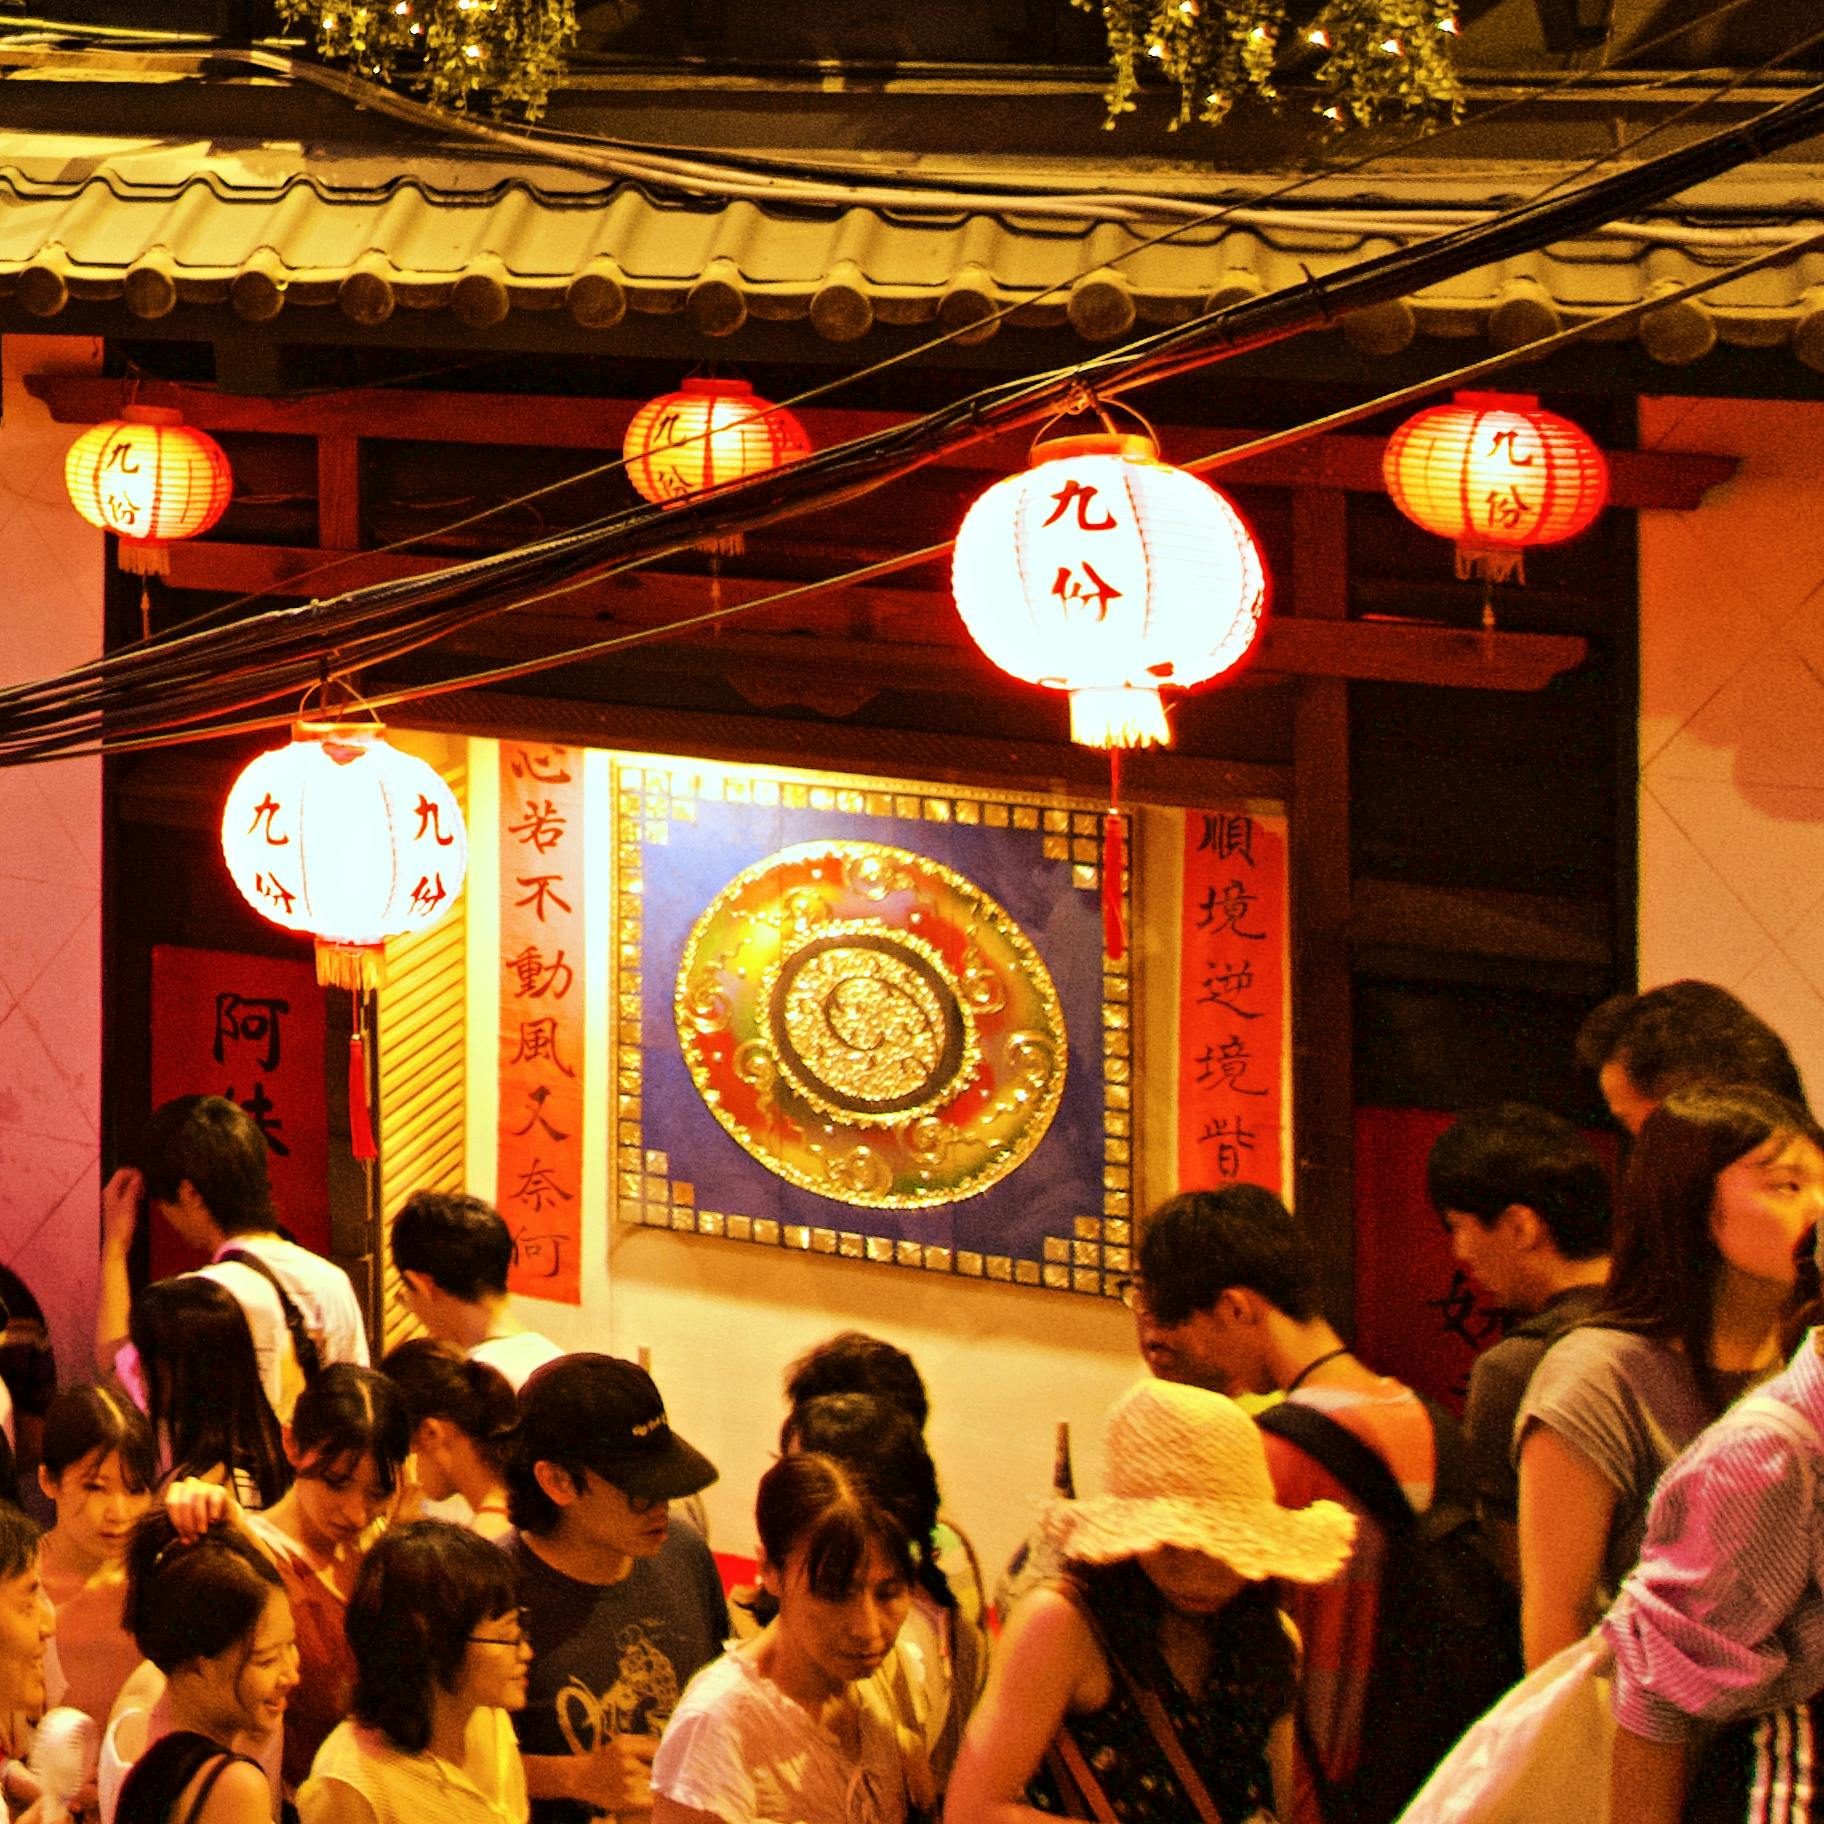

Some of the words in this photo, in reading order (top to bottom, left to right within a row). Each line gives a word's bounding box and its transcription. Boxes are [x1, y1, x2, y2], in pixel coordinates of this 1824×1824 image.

[106, 441, 141, 526] 九份
[1483, 430, 1532, 530] 九份
[1041, 478, 1123, 626] 九份
[245, 791, 297, 915] 九份
[407, 792, 454, 917] 九份
[504, 748, 575, 1278] 心若不動風又奈何
